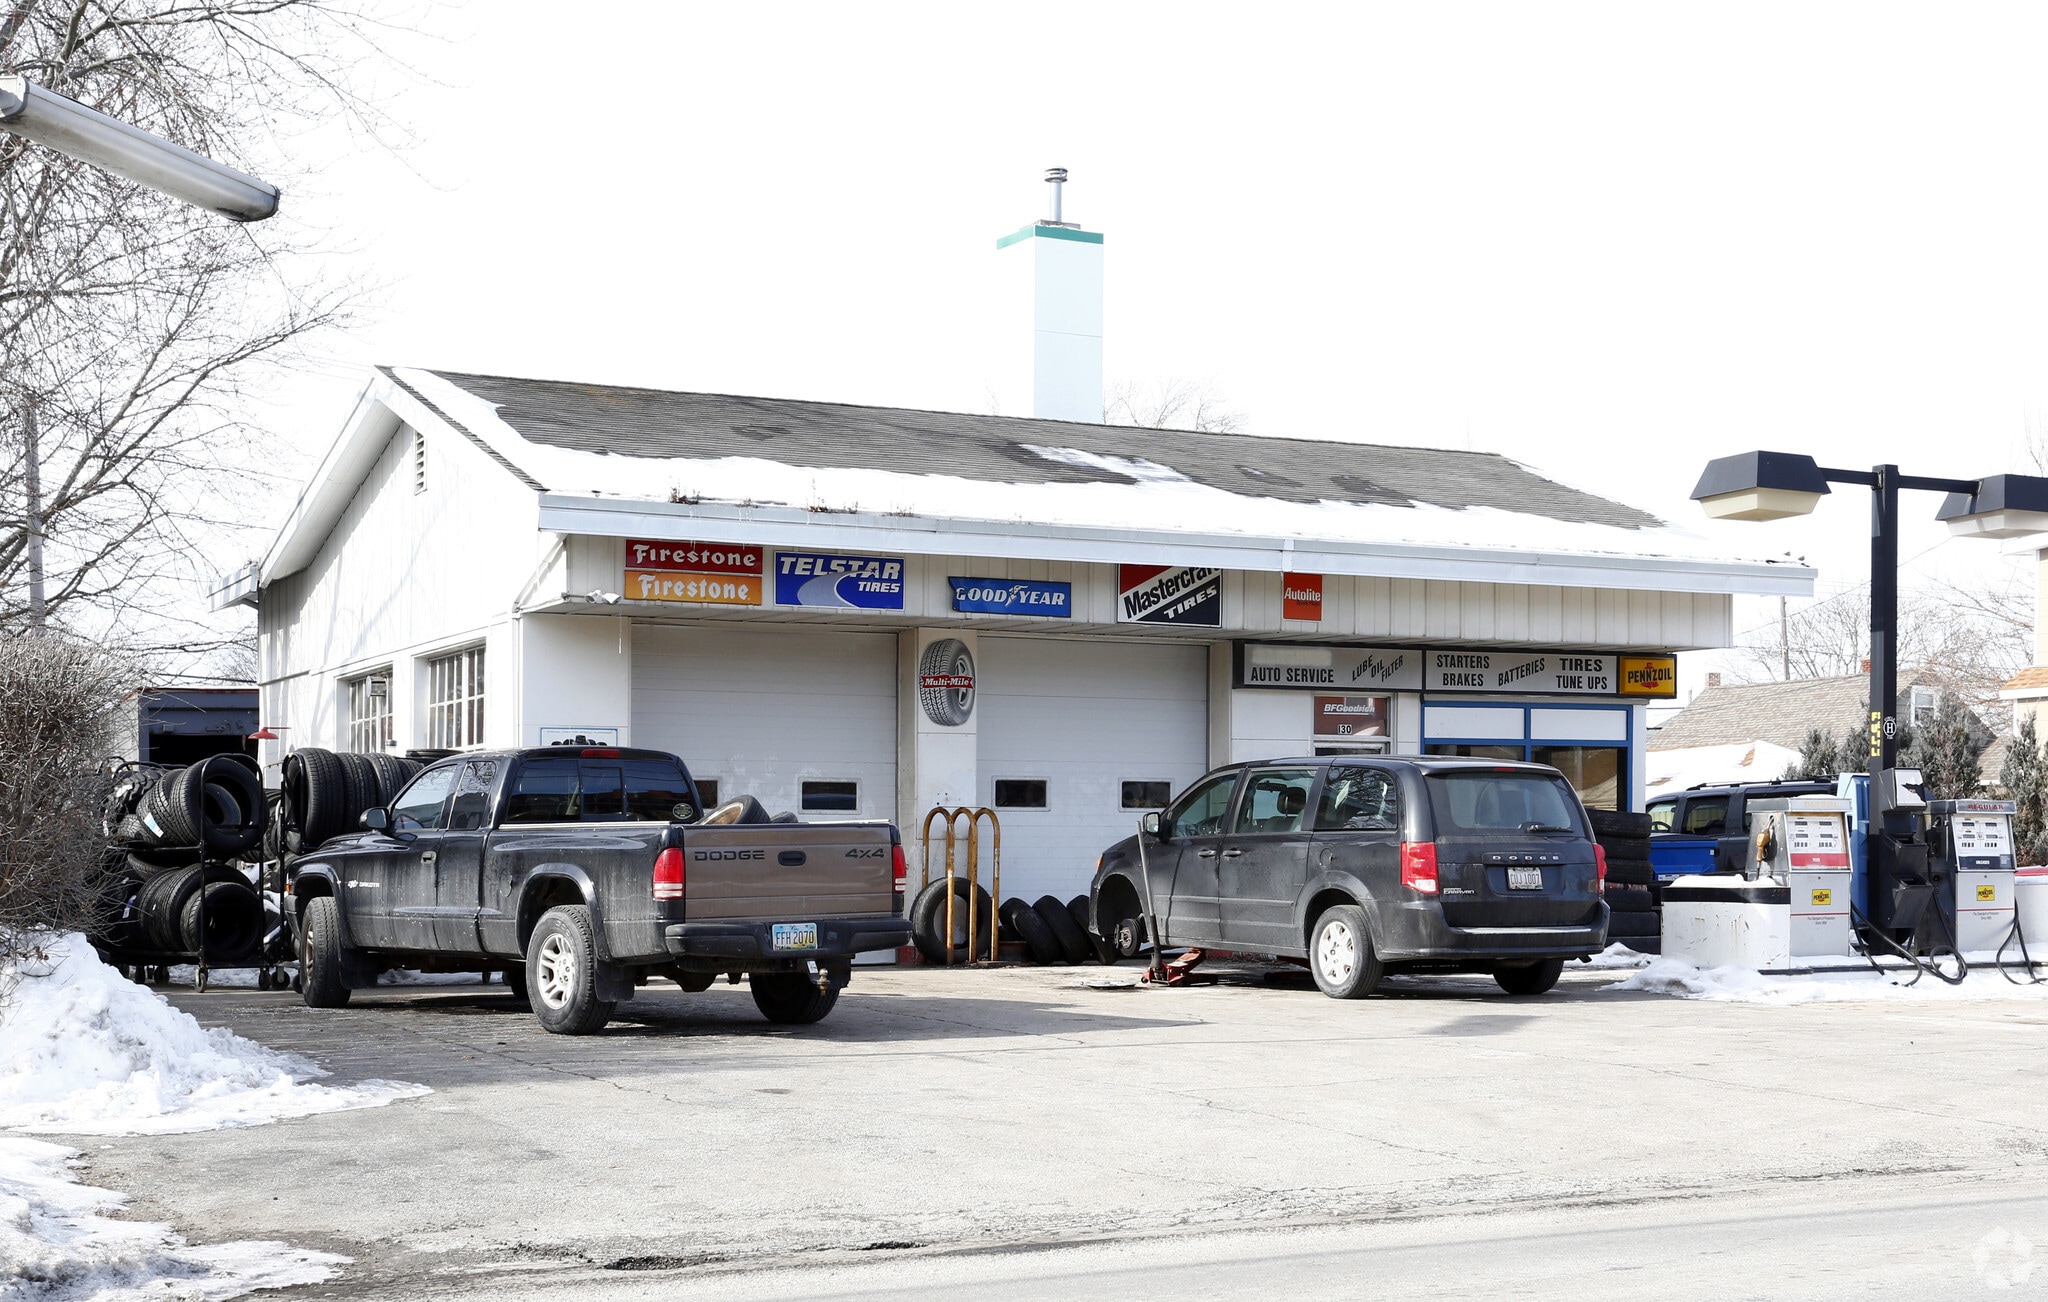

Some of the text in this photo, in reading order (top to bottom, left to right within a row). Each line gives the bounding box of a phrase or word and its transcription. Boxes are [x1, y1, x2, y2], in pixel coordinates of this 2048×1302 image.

[633, 544, 756, 566] Firestone
[780, 557, 901, 579] TELSTAR
[638, 574, 749, 600] Firestone
[858, 581, 900, 593] TIRES
[1123, 567, 1220, 619] Mastercra
[1284, 587, 1321, 601] Autolite
[1163, 585, 1217, 619] TIRES
[1352, 654, 1373, 681] LUBE
[1371, 659, 1385, 678] OIL
[1381, 654, 1403, 682] FILTER
[1436, 654, 1490, 669] STARTERS
[1559, 657, 1603, 672] TIRES
[1250, 667, 1335, 683] AUTO SERVICE
[1442, 672, 1484, 687] BRAKES
[1498, 657, 1545, 687] BATTERIES
[1627, 667, 1673, 684] PENNZOIL
[924, 678, 969, 686] Multi-Mile
[1555, 675, 1608, 690] TUNE UPS
[1324, 704, 1375, 713] BFGoodrich
[1338, 725, 1352, 734] 130
[694, 850, 765, 861] DODGE
[775, 930, 815, 945] FFH 2070
